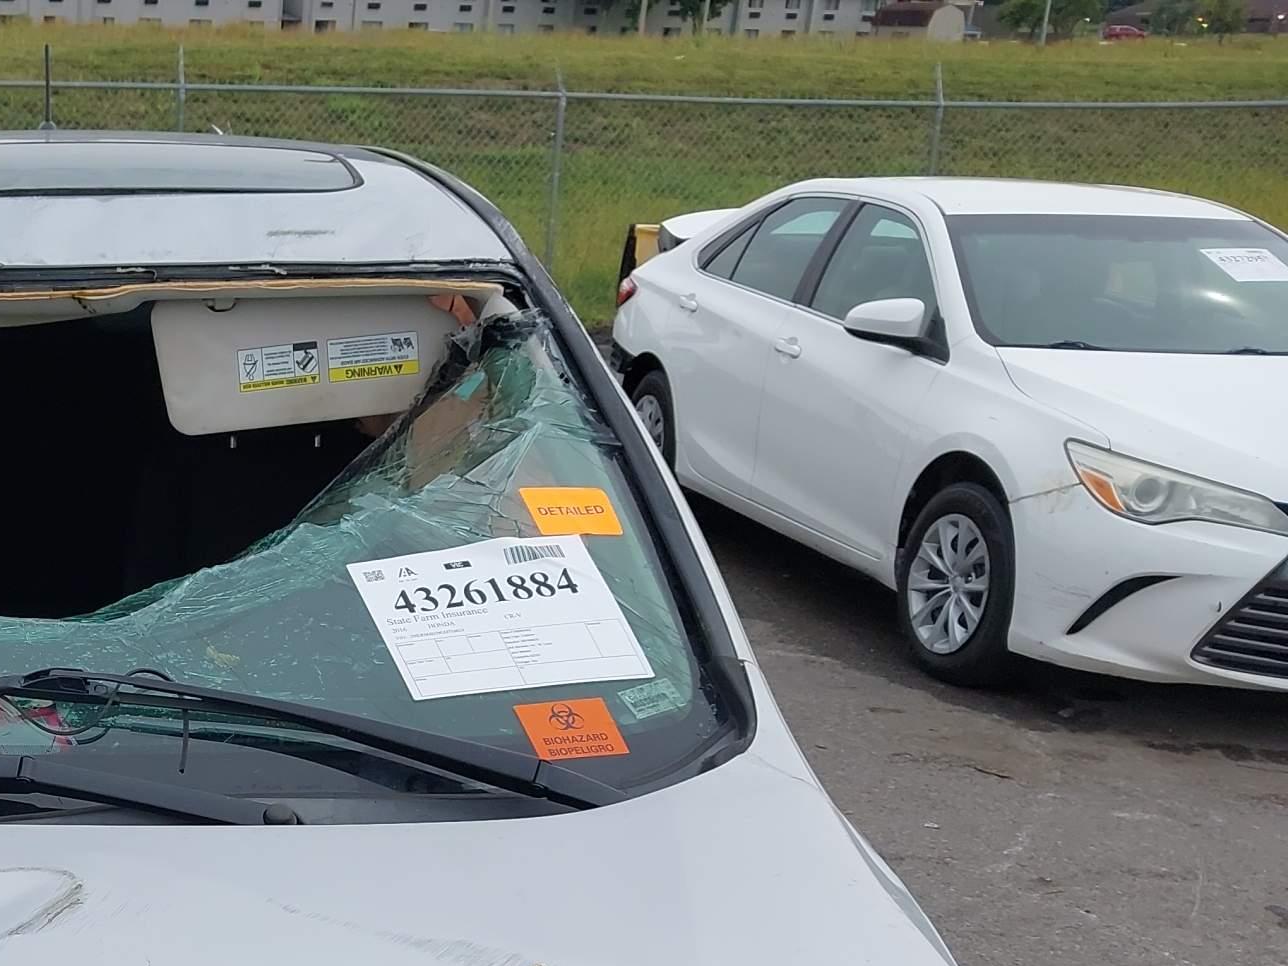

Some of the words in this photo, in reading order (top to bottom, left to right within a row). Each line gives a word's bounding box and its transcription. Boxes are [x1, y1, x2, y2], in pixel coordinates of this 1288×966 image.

[345, 364, 393, 379] WARNING
[537, 505, 605, 516] DETAILED
[394, 567, 580, 614] 43261884
[386, 615, 412, 626] State
[413, 613, 440, 623] Farm
[440, 608, 489, 619] Insurance
[427, 620, 457, 630] HONDA
[543, 732, 609, 745] BIOHAZARD
[548, 743, 615, 757] BIOPELIGRO
